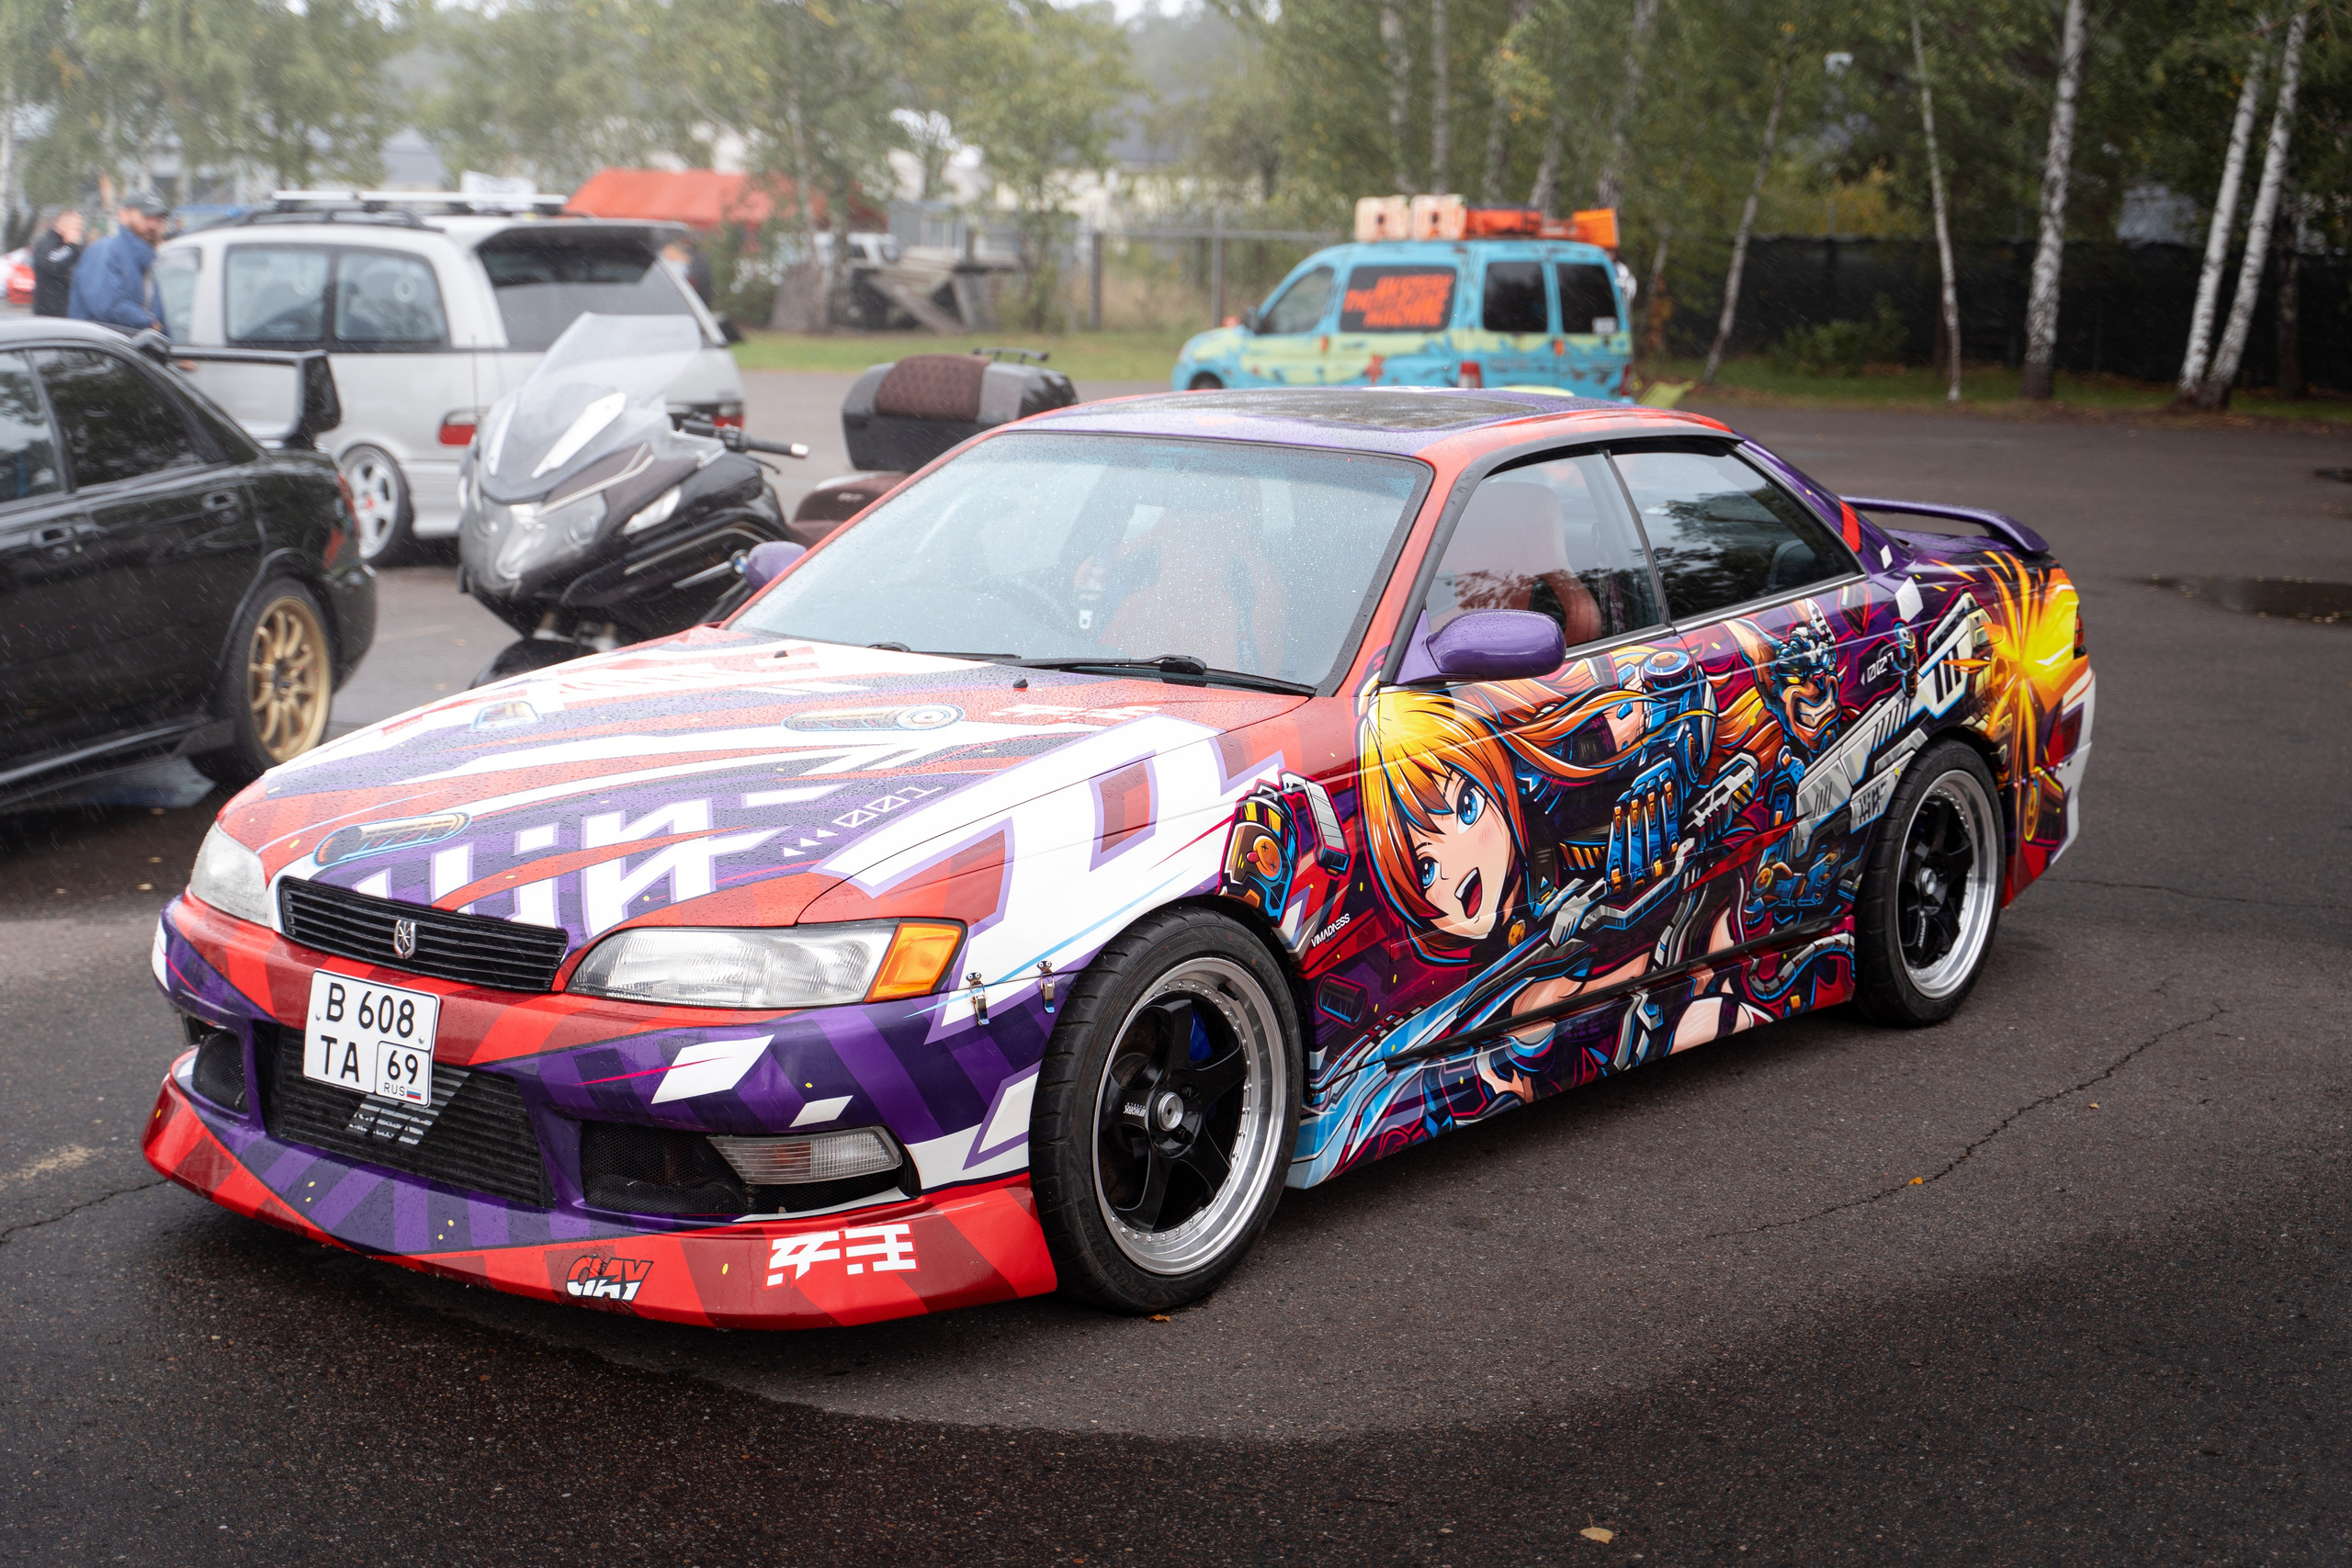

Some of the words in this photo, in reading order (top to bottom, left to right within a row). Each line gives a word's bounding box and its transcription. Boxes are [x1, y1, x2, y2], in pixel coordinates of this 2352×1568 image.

[358, 990, 415, 1038] 608
[388, 1050, 418, 1085] 69
[383, 1082, 405, 1097] RUS
